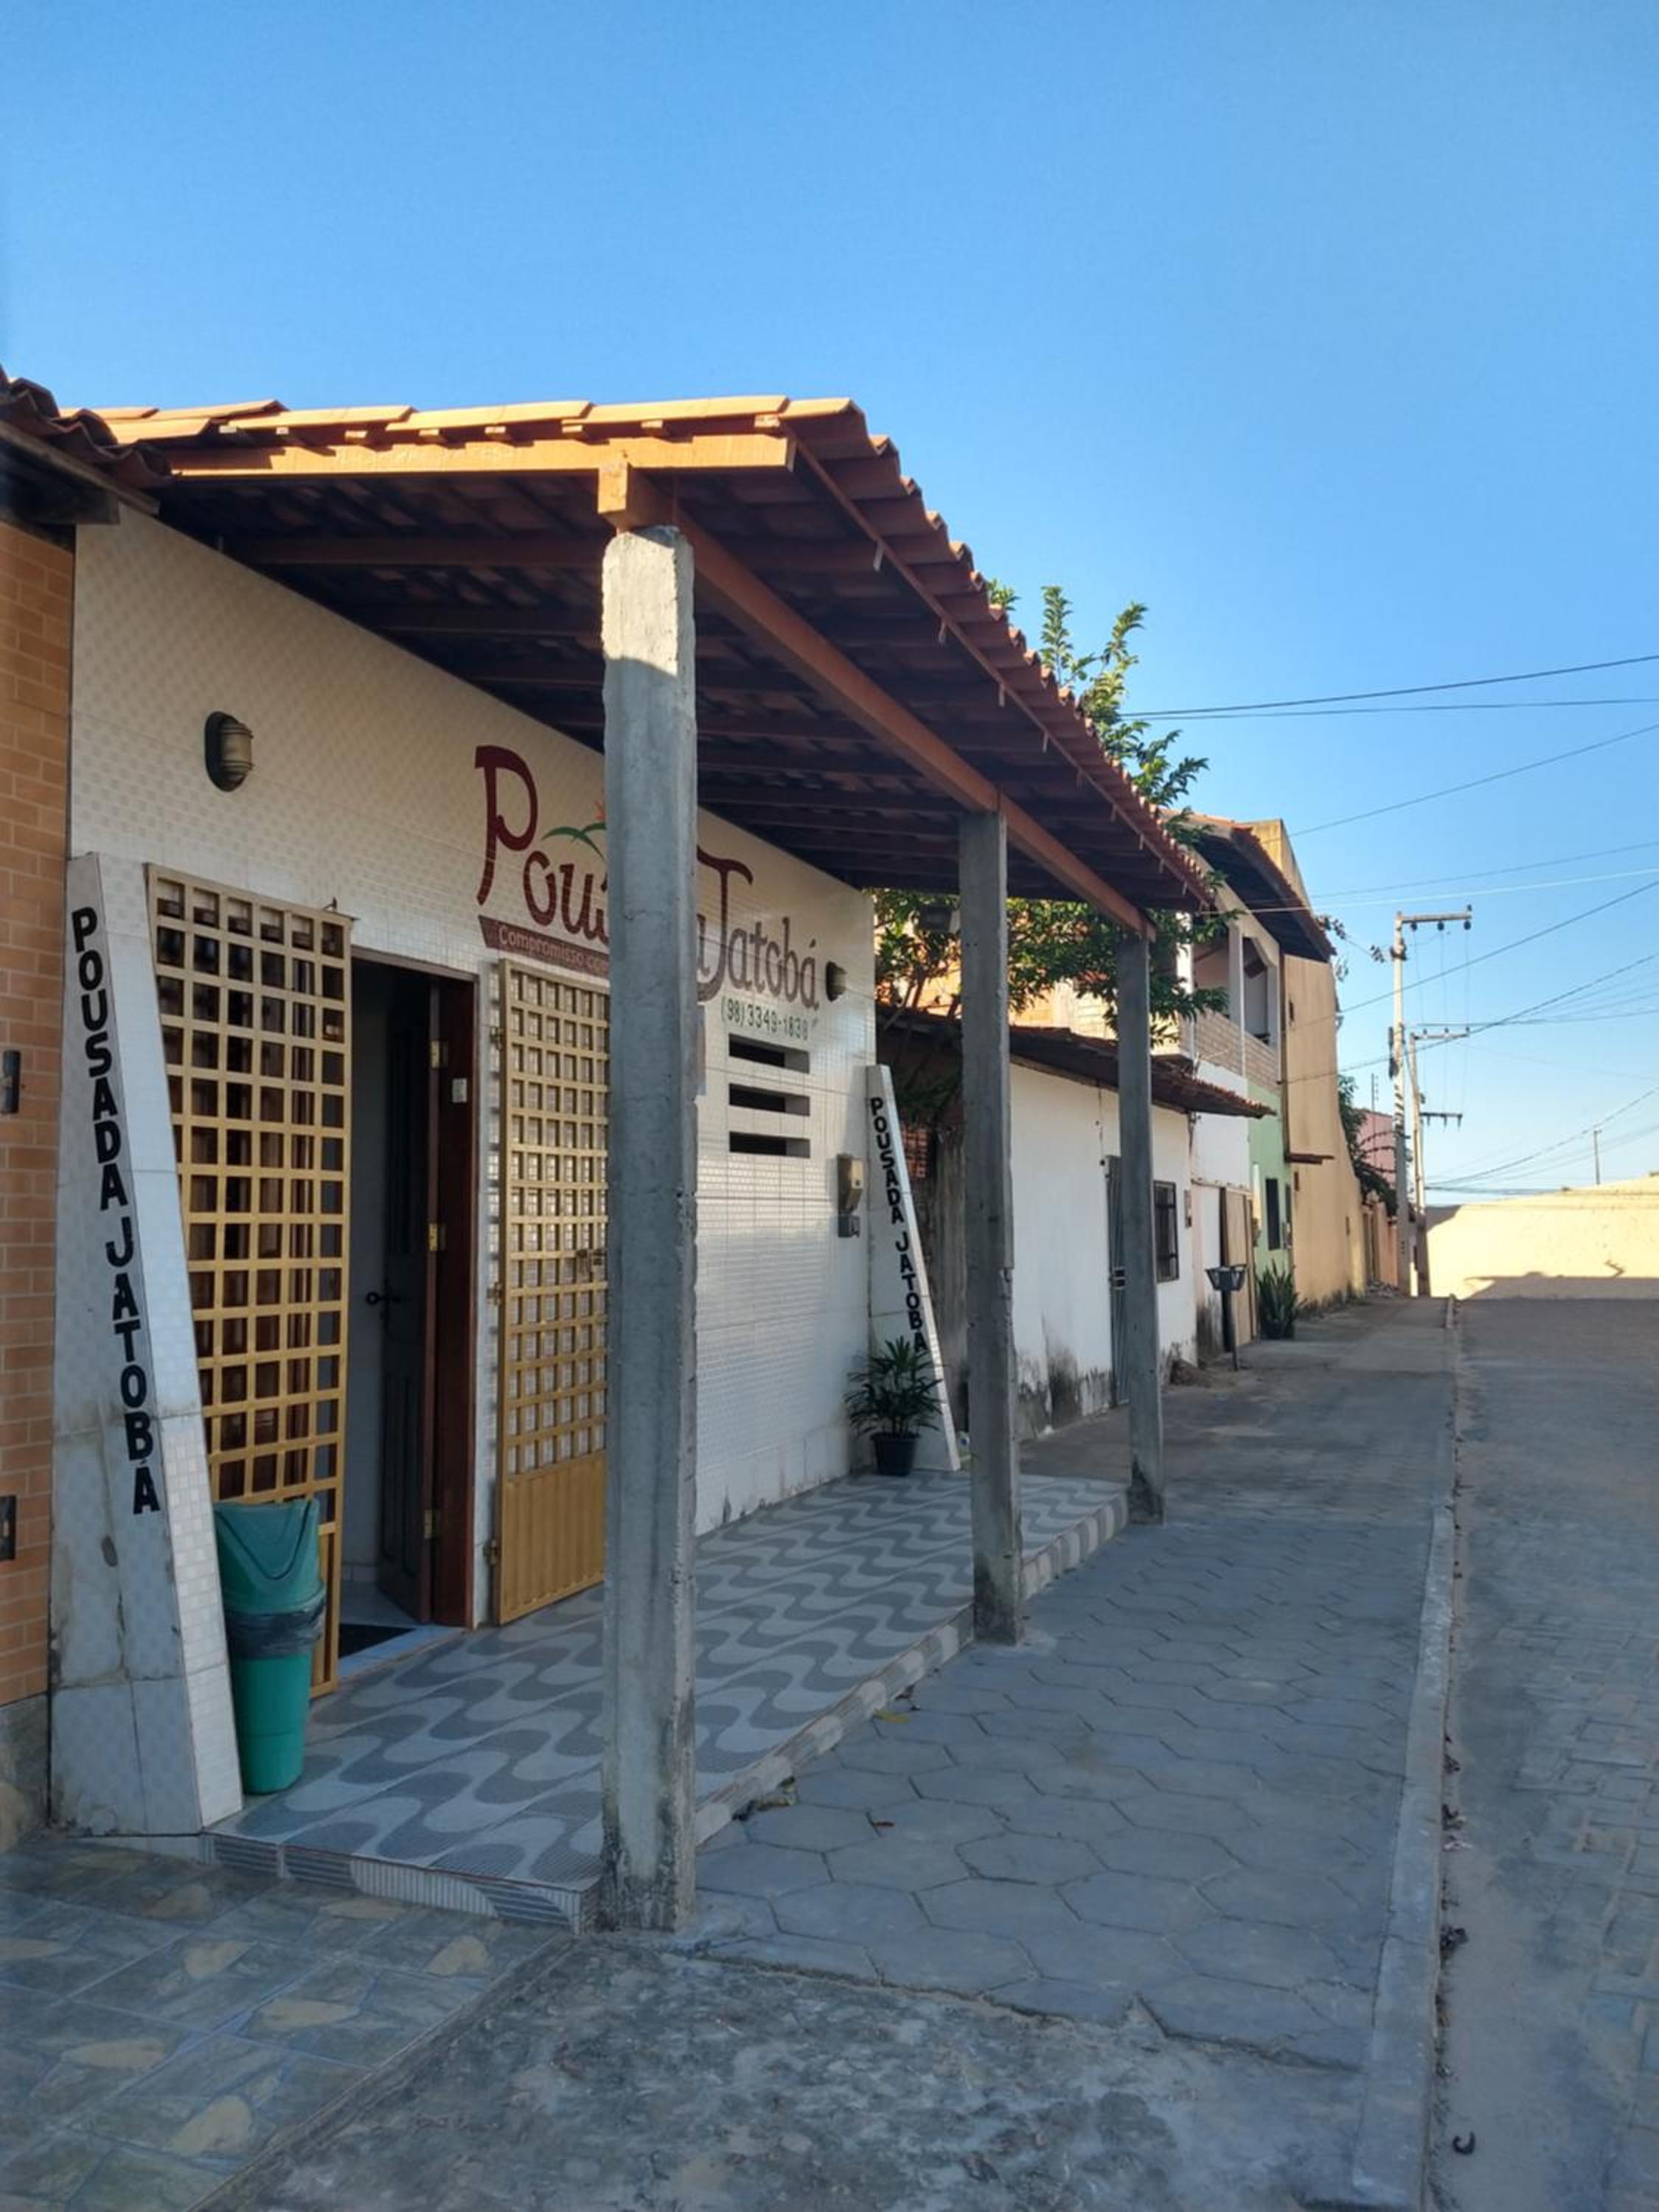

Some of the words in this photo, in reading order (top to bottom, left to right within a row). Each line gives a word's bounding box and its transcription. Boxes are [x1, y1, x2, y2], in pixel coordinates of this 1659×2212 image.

[72, 906, 128, 1211] POUSADA
[105, 1216, 161, 1515] JATOBÁ
[870, 1096, 905, 1225] POUSADA
